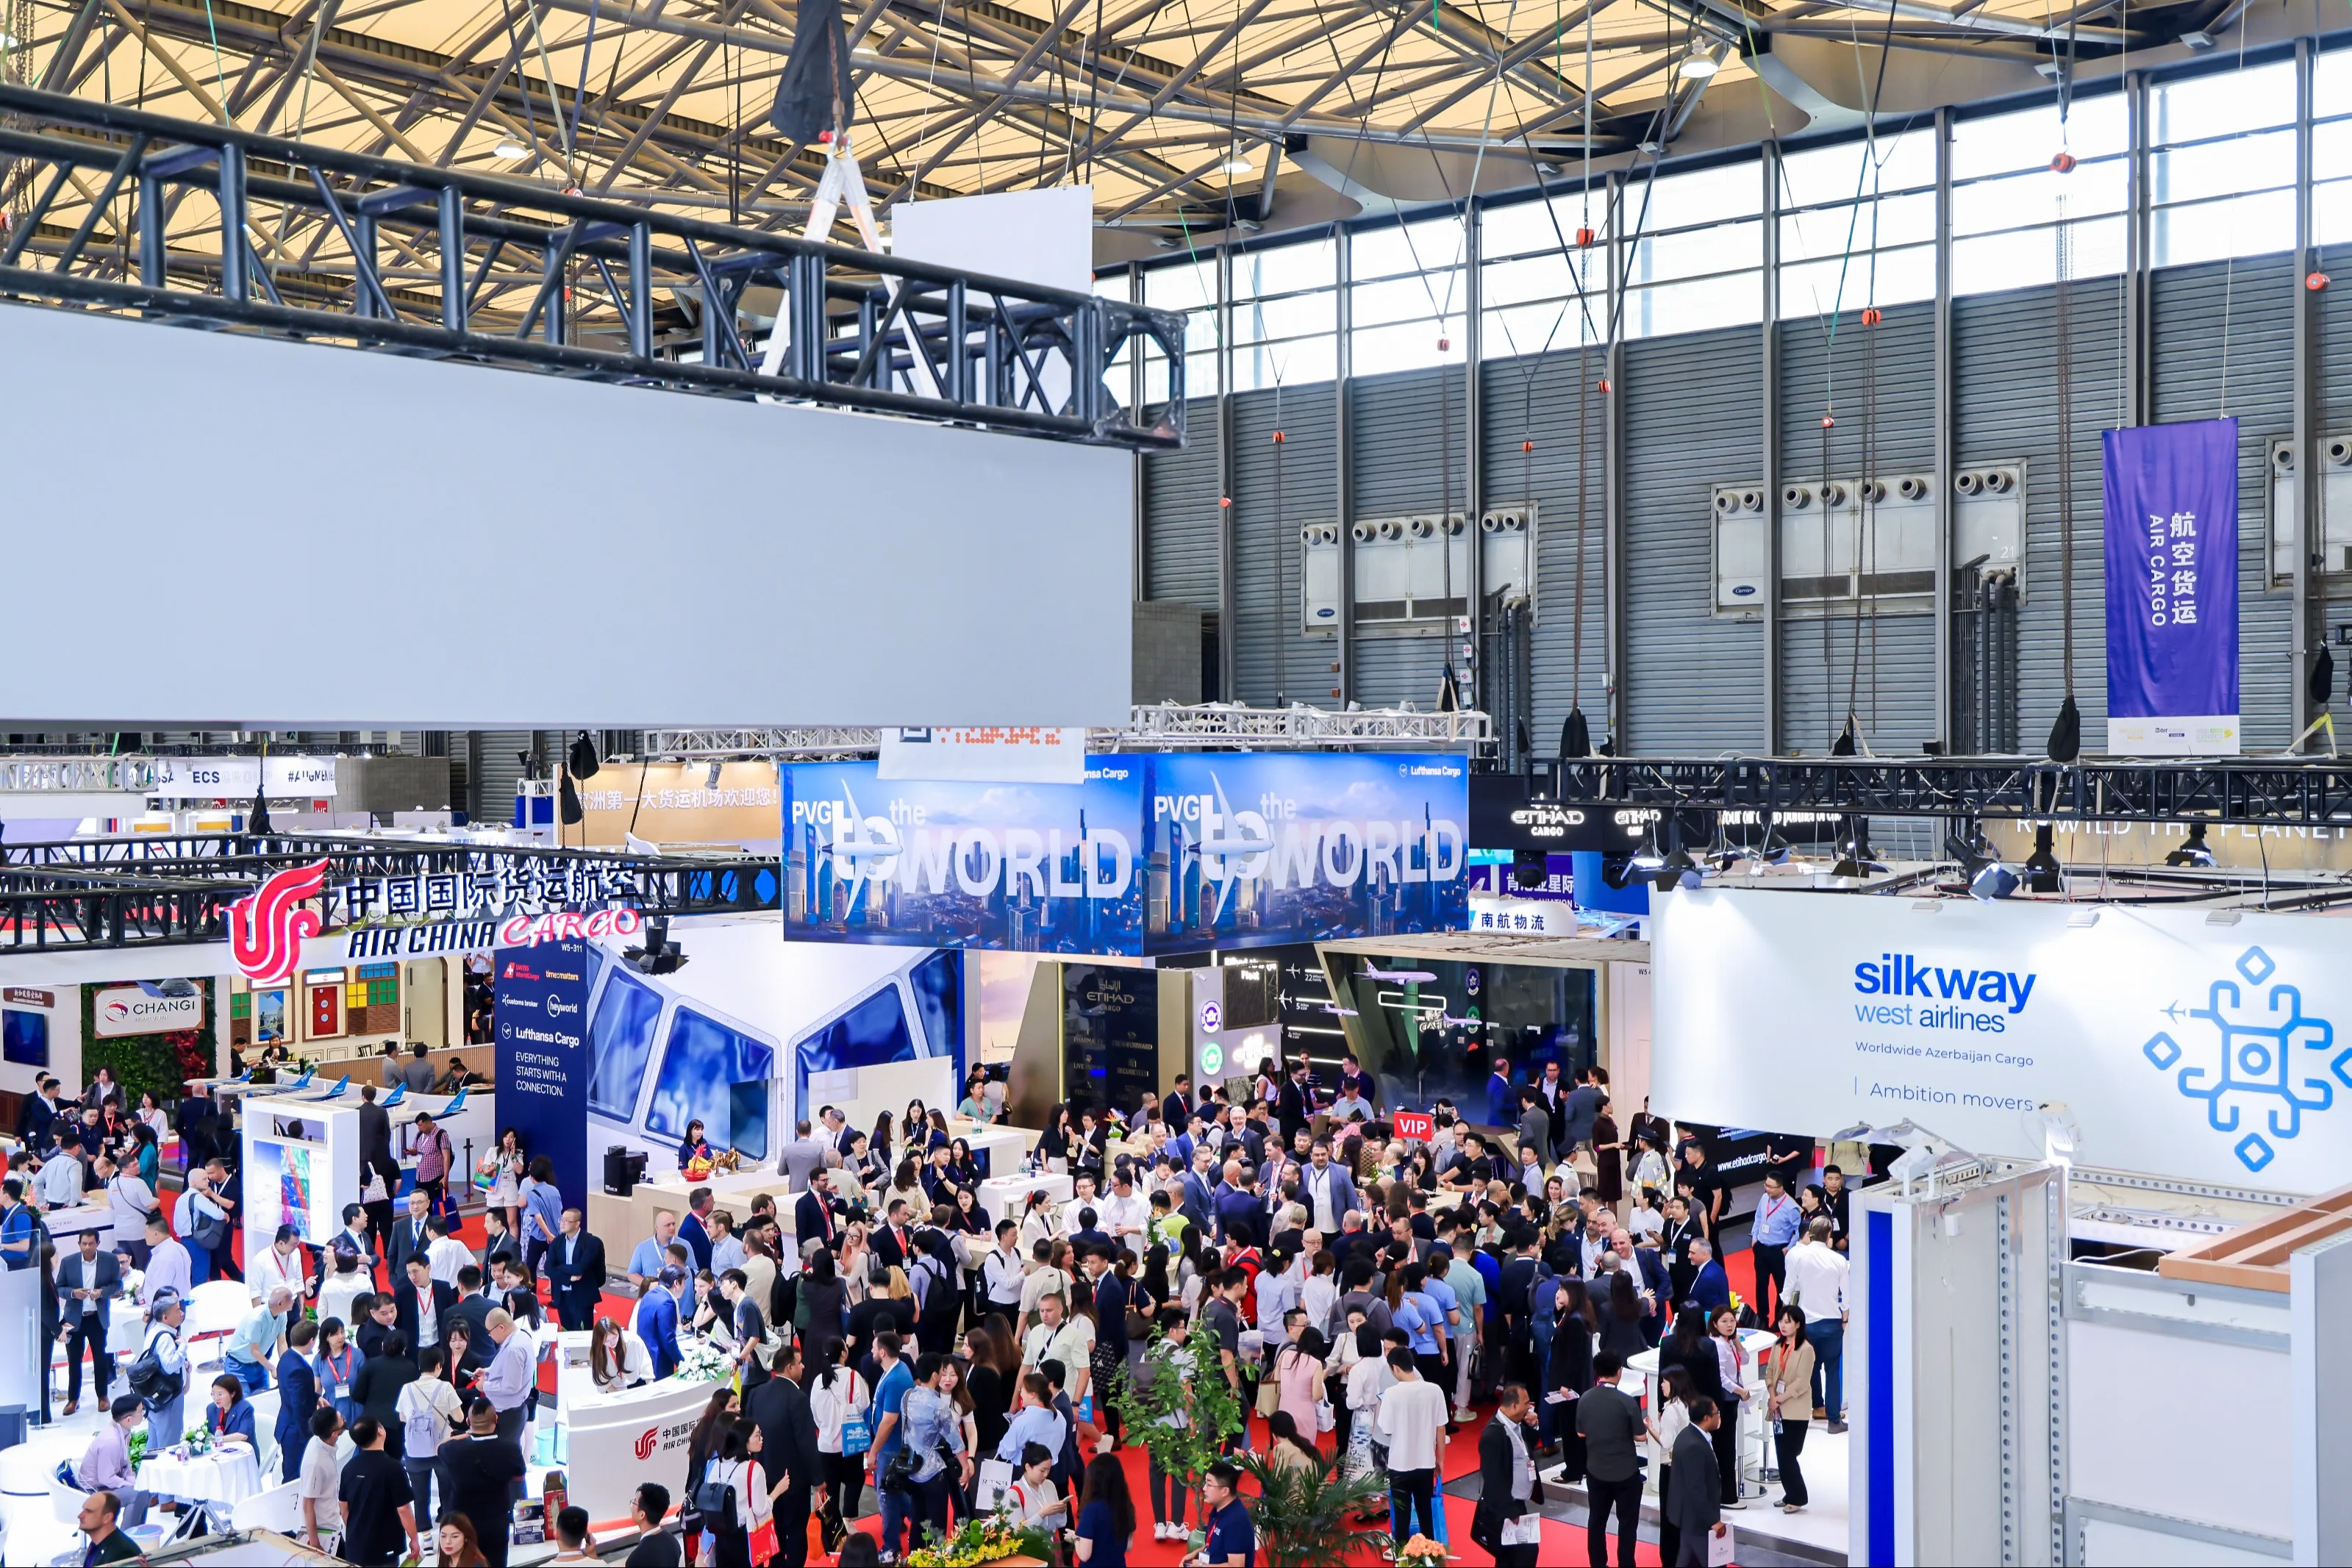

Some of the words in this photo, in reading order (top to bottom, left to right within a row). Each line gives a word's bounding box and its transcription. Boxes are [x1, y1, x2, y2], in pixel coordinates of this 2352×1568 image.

[2149, 514, 2165, 548] AIR
[2001, 546, 2014, 559] 21
[2170, 512, 2198, 625] 航空货运
[2151, 558, 2167, 626] CARGO
[193, 771, 220, 784] ECS
[1102, 767, 1129, 781] Cargo
[1410, 766, 1441, 776] Lufthansa
[1442, 766, 1461, 778] Cargo
[792, 801, 832, 825] PVG
[889, 798, 926, 826] the
[1154, 796, 1199, 822] PVG
[1260, 792, 1297, 820] the
[1511, 810, 1584, 825] ETIHAD
[1531, 826, 1564, 837] CARGO
[898, 827, 1132, 899] WORLD
[1270, 819, 1463, 890] WORLD
[346, 863, 637, 919] 中国国际货运航空
[1481, 912, 1545, 931] 南航物流
[348, 928, 401, 959] AIR
[405, 921, 498, 954] CHINA
[501, 908, 640, 948] CARGO
[561, 942, 583, 953] W5-311
[546, 969, 579, 981] time:matters
[1854, 953, 2037, 1014] silkway
[506, 998, 524, 1007] customs
[524, 999, 539, 1008] broker
[1087, 992, 1134, 1004] ETIHAD
[133, 1000, 195, 1015] CHANGI
[549, 1000, 578, 1017] heyworld
[1100, 1004, 1121, 1012] CARGO
[1854, 1003, 1913, 1025] west
[1919, 1004, 2006, 1033] airlines
[515, 1026, 554, 1043] Lufthansa
[554, 1031, 580, 1049] Cargo
[515, 1051, 560, 1067] EVERYTHING
[1855, 1041, 1922, 1056] Worldwide
[1925, 1047, 1992, 1064] Azerbaijan
[1995, 1053, 2034, 1067] Cargo
[516, 1066, 542, 1078] STARTS
[542, 1070, 561, 1082] WITH
[561, 1072, 567, 1083] A
[516, 1080, 564, 1098] CONNECTION.
[1870, 1082, 1956, 1105] Ambition
[1963, 1093, 2034, 1111] movers
[1399, 1118, 1427, 1135] VIP
[1717, 1152, 1767, 1172] www.etihadcargo.
[662, 1417, 701, 1439] 中国国际
[663, 1441, 675, 1451] AIR
[676, 1436, 691, 1447] CHIN
